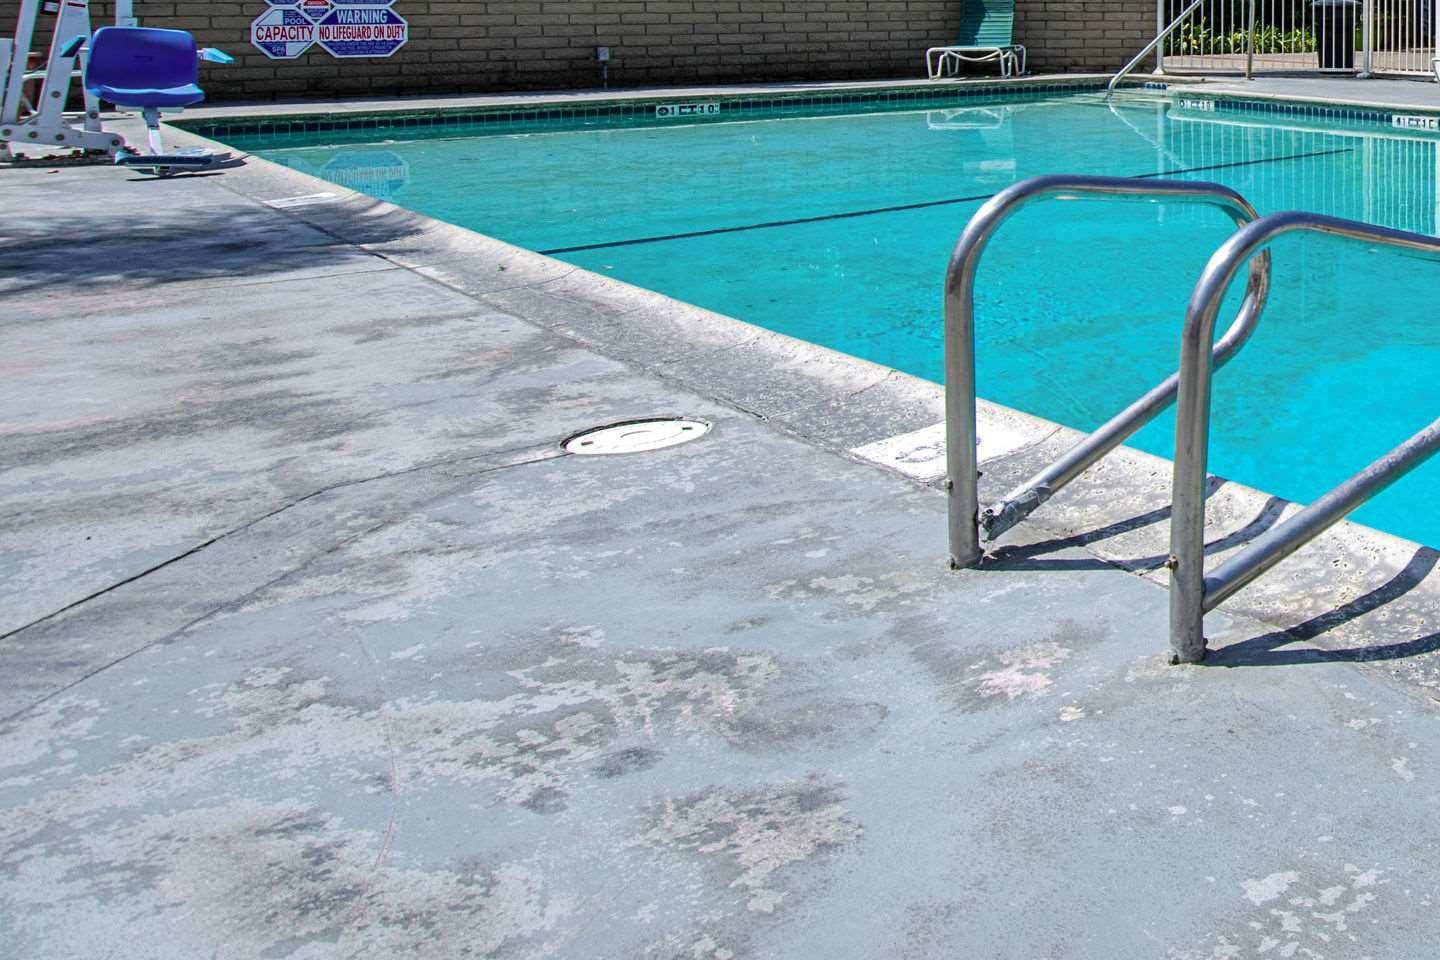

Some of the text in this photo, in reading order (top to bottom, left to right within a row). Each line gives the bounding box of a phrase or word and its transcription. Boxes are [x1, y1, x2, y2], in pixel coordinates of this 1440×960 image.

[284, 17, 307, 25] POOL
[336, 9, 388, 24] WARNING
[256, 26, 314, 40] CAPACITY
[319, 25, 405, 40] NO LIFEGUARD ON DUTY
